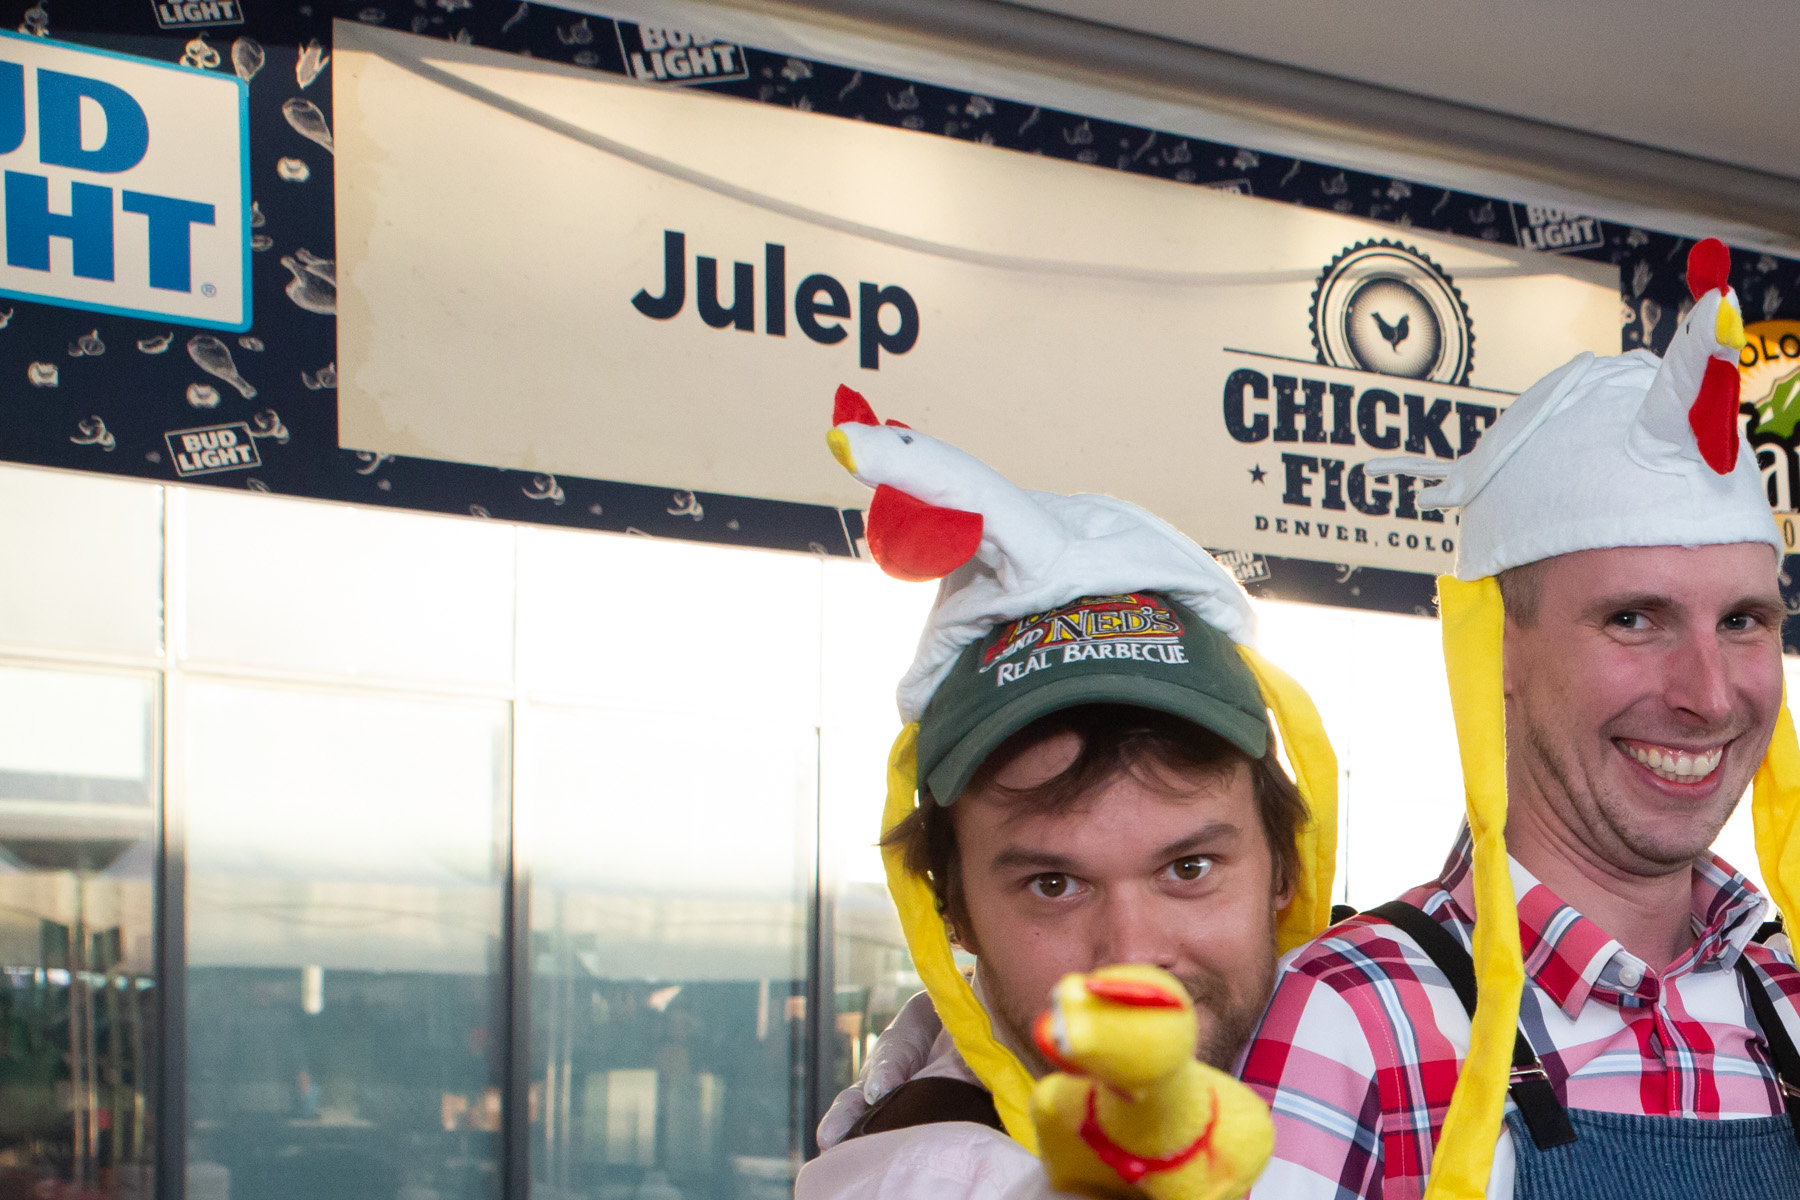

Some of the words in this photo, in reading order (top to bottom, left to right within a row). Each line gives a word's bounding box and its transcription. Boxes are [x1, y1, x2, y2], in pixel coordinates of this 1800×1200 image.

[159, 1, 234, 24] LIGHT
[630, 45, 736, 81] LIGHT
[1520, 219, 1595, 251] LIGHT
[630, 228, 920, 371] Julep
[1222, 367, 1504, 461] CHICKE
[177, 444, 252, 472] LIGHT
[181, 429, 238, 453] BUD
[996, 651, 1053, 688] REAL
[1062, 643, 1190, 665] BARBECUE
